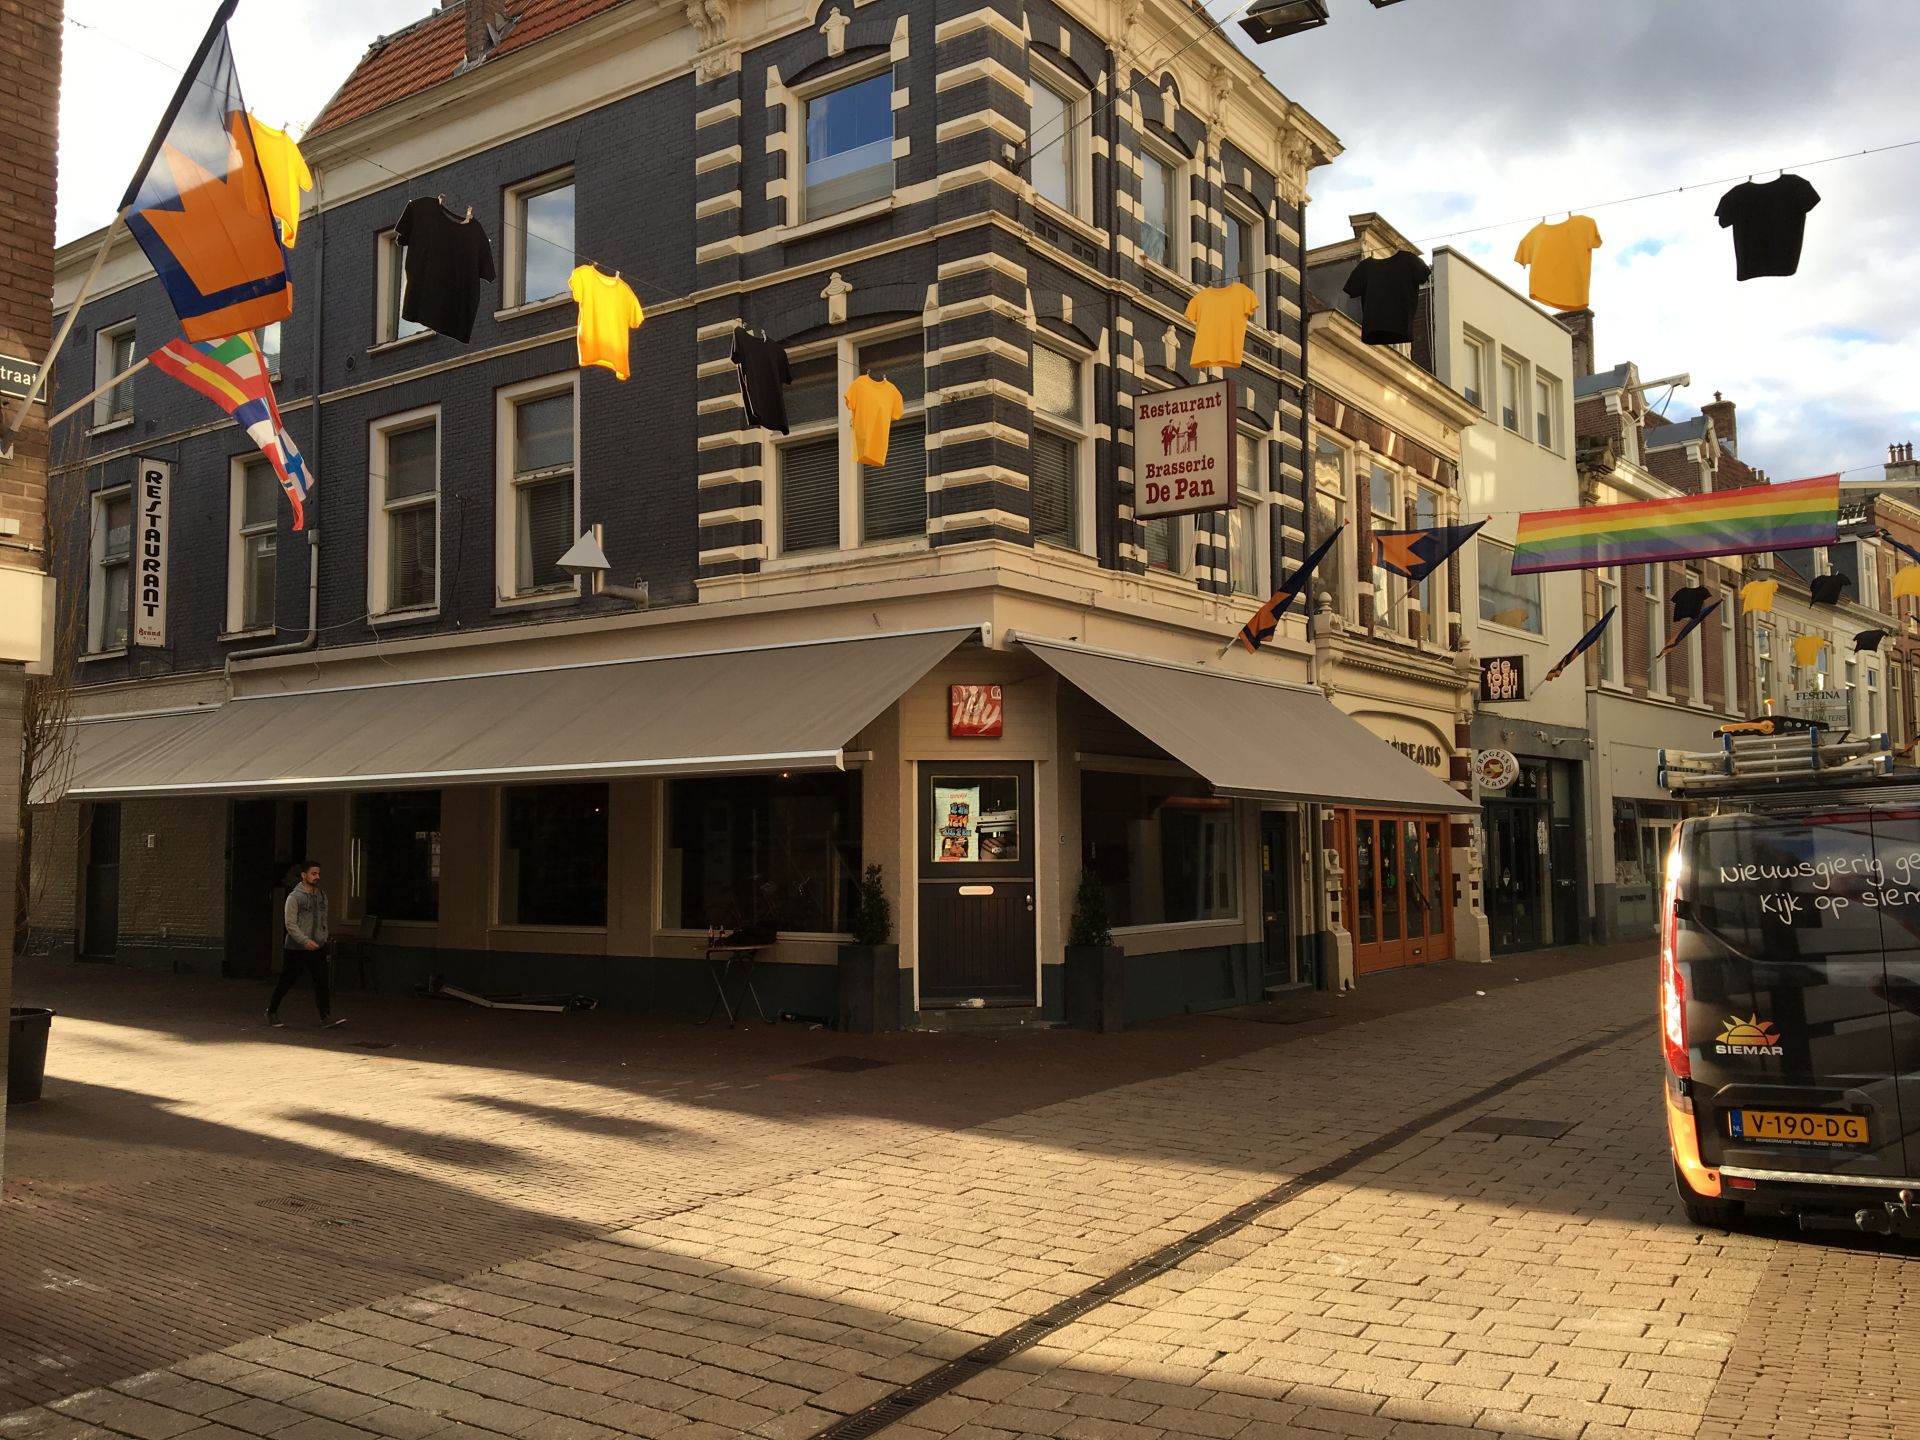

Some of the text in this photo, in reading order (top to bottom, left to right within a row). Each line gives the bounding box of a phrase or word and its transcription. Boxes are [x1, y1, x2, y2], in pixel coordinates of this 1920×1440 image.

[1139, 391, 1222, 420] Restaurant
[1145, 454, 1215, 479] Brasserie
[1145, 477, 1215, 505] De Pan
[142, 470, 163, 617] RESTAURANT
[1490, 658, 1511, 674] de
[1487, 669, 1518, 688] tosti
[1491, 683, 1517, 700] bar
[1796, 691, 1840, 701] FESTINA
[1478, 751, 1510, 764] BAGELS
[1480, 775, 1509, 787] BEANS
[1720, 854, 1885, 890] Nieuwsgierig
[1760, 892, 1803, 925] Kijk
[1815, 896, 1849, 920] op
[1716, 1045, 1783, 1056] SIEMAR
[1752, 1114, 1858, 1139] V-190-DG
